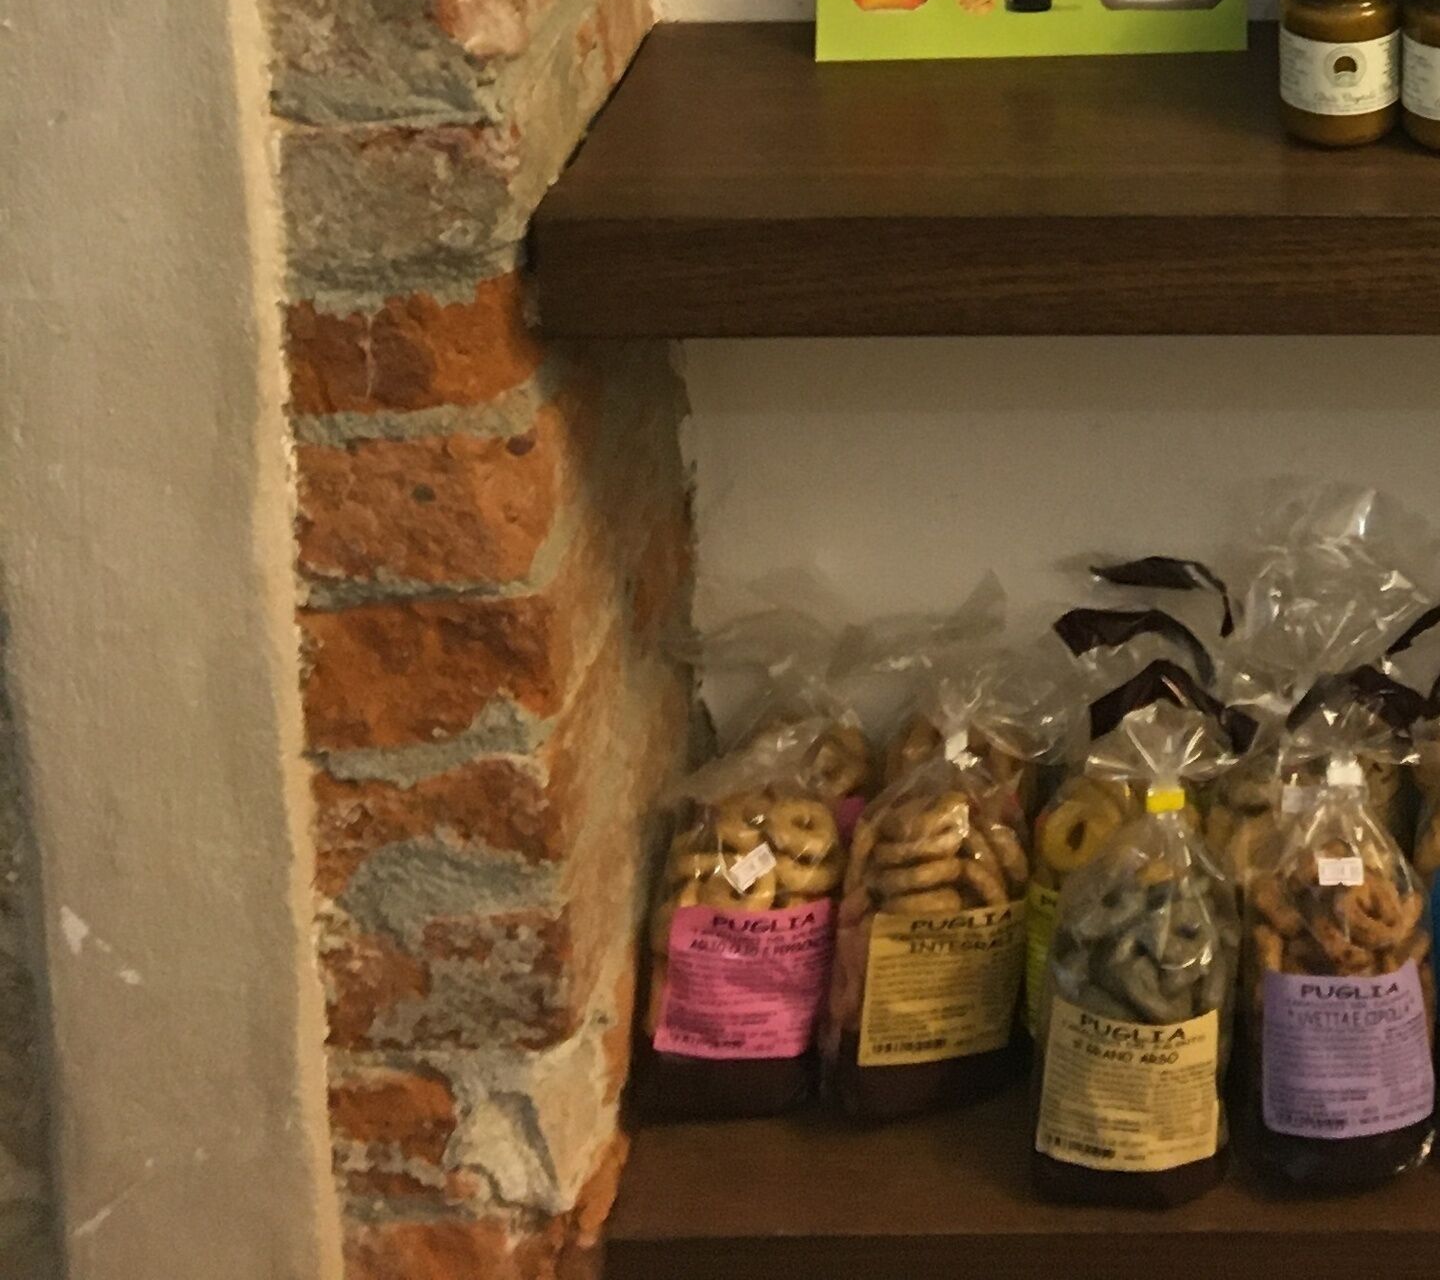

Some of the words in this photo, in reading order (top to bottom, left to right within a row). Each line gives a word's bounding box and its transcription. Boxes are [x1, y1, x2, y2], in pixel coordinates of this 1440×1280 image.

[712, 912, 816, 934] PUGLIA
[910, 908, 1013, 933] PUGLIA
[1300, 981, 1400, 1000] PUGLIA
[1080, 1012, 1187, 1043] PUGLIA
